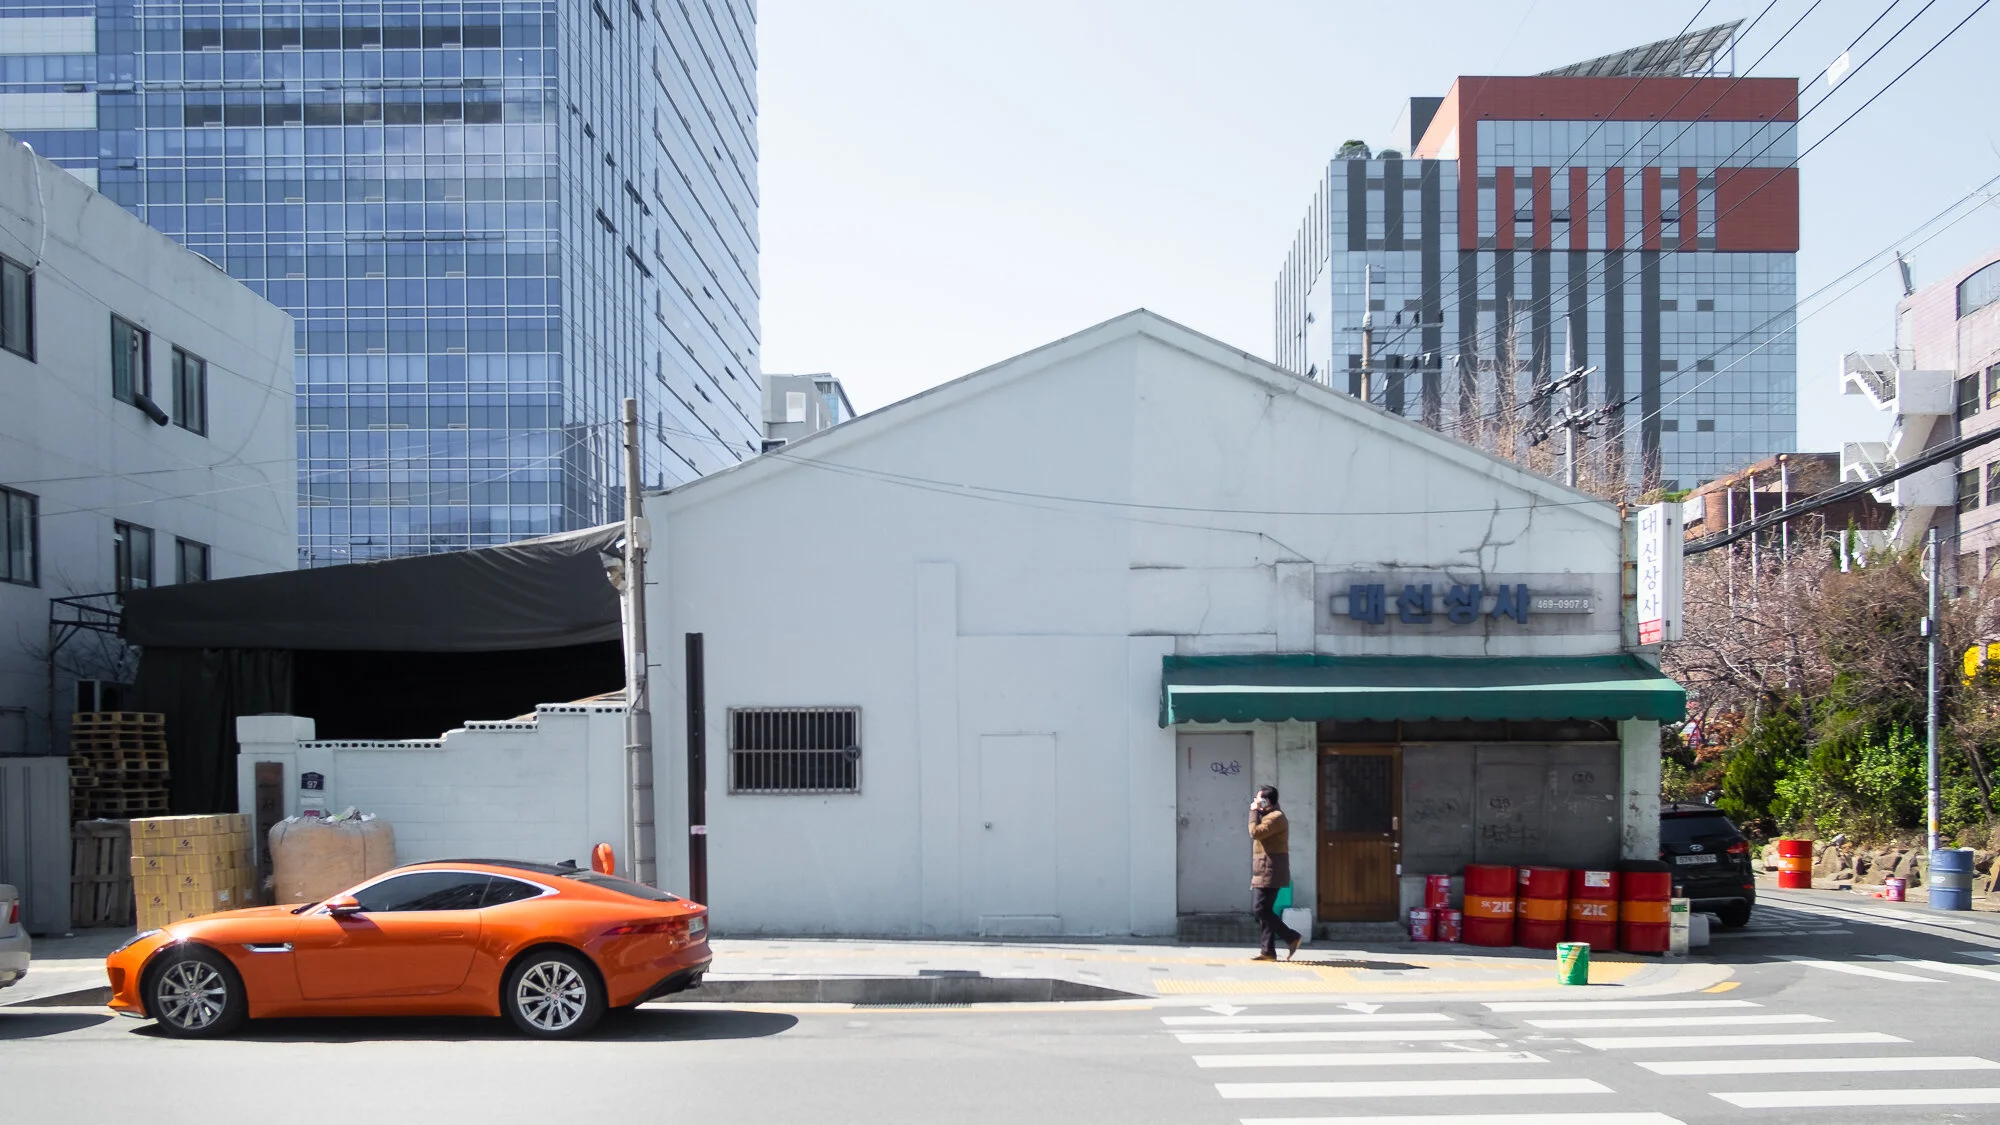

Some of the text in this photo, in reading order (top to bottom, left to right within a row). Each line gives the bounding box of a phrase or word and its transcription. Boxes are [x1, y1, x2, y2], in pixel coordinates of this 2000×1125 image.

[1641, 510, 1660, 617] 대신상사
[1349, 584, 1528, 624] 대신상사
[307, 780, 318, 789] 97
[1491, 901, 1513, 913] ZIC
[1582, 903, 1609, 916] ZIC
